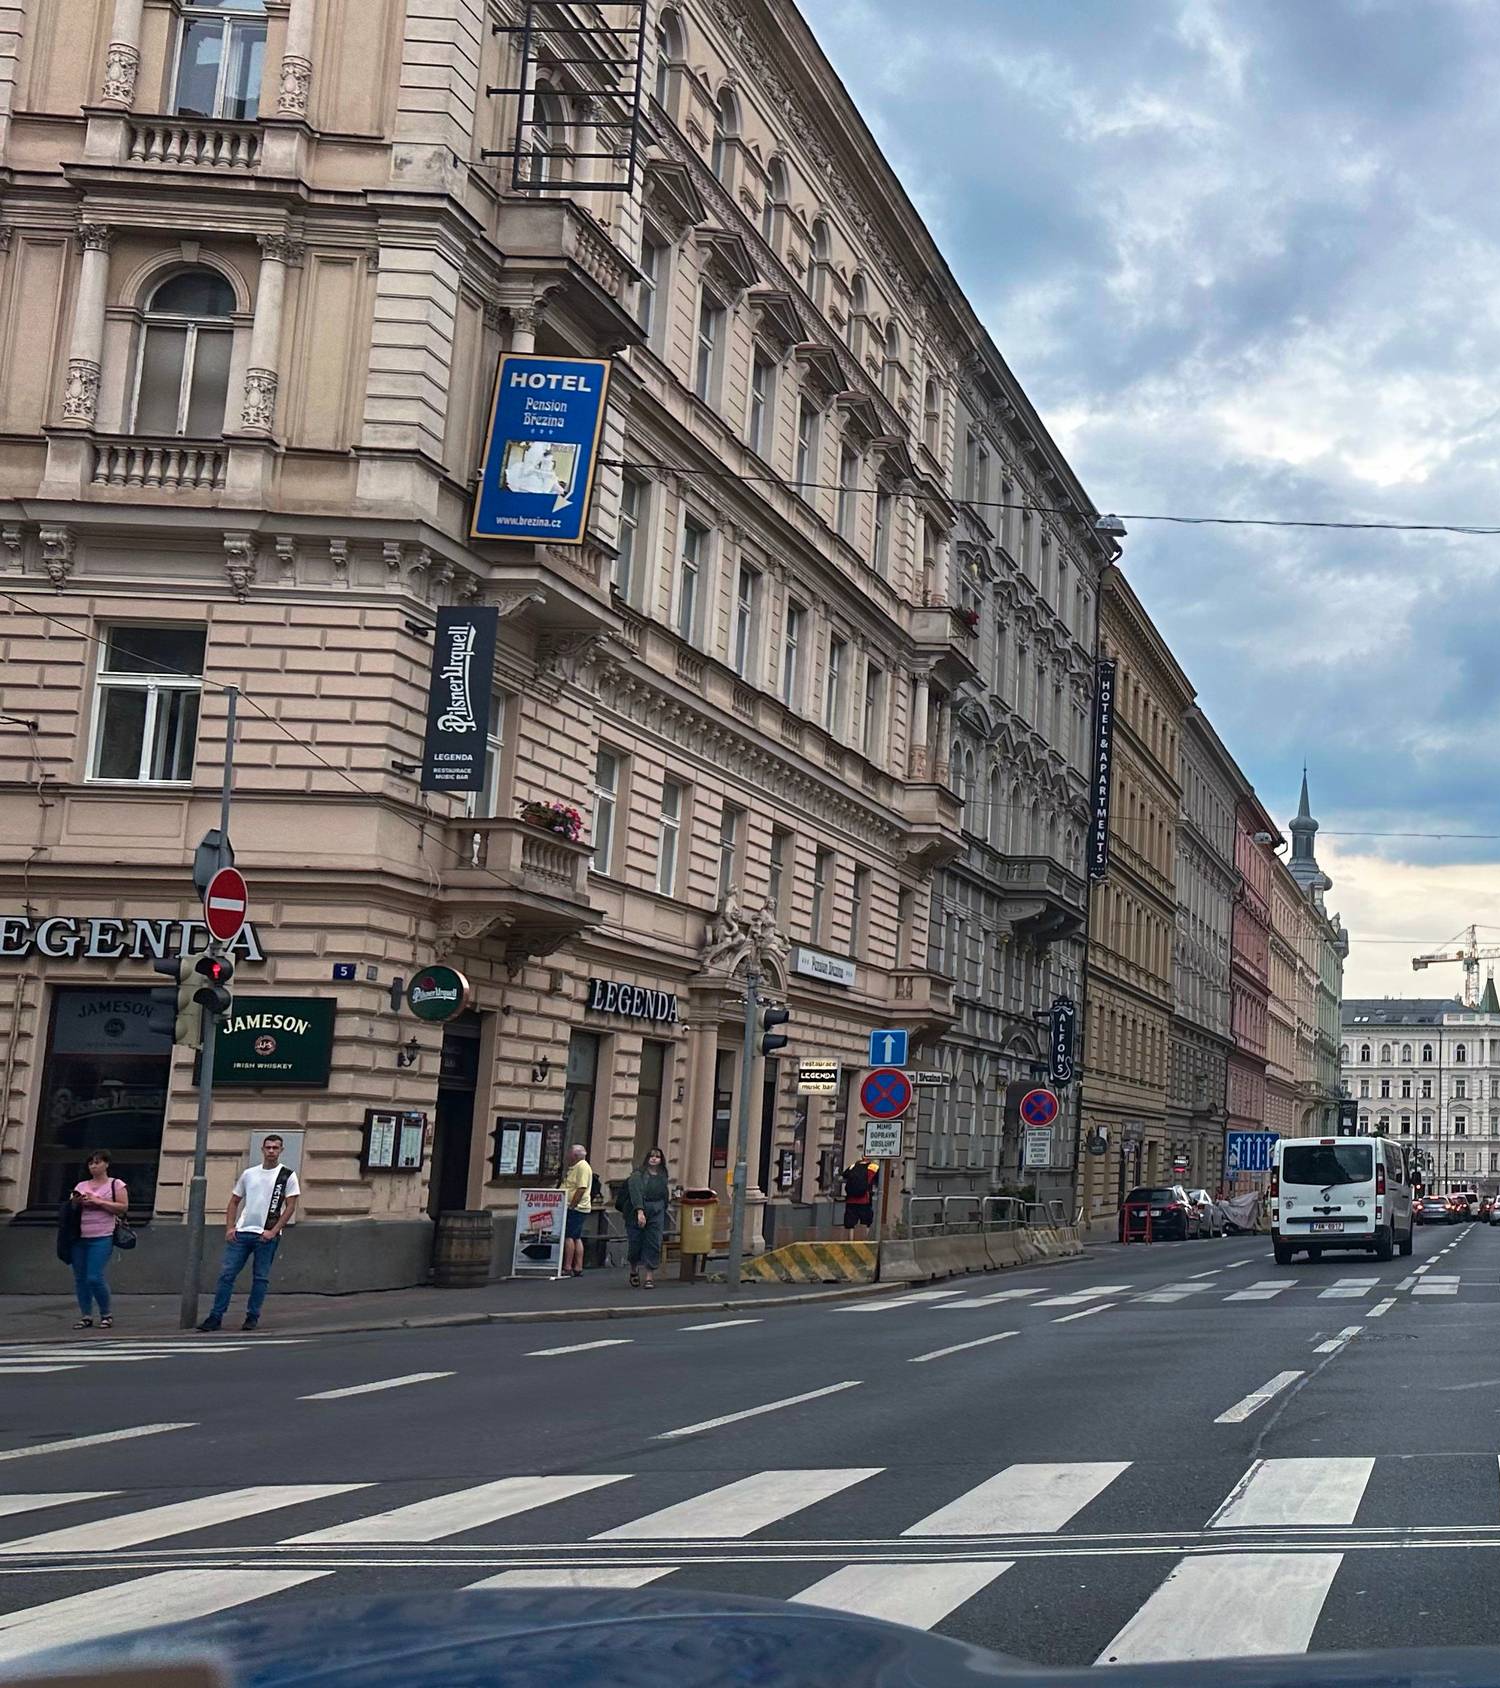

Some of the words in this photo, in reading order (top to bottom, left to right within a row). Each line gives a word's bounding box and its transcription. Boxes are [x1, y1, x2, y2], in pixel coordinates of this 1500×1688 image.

[510, 372, 592, 393] HOTEL
[525, 397, 567, 412] Pension
[523, 412, 565, 427] Březina
[496, 516, 562, 528] www.brezina.cz
[440, 626, 476, 679] Urquell
[437, 676, 477, 734] Pilsner
[1101, 681, 1110, 735] HOTEL
[1100, 738, 1109, 748] &
[434, 753, 473, 761] LEGENDA
[1096, 752, 1108, 864] APARTMENTS
[341, 966, 348, 976] 5
[78, 1000, 154, 1018] JAMESON
[592, 980, 679, 1022] LEGENDA
[223, 1014, 309, 1035] JAMESON
[1057, 1013, 1066, 1073] ALFONS
[257, 1062, 293, 1070] WHISKEY
[801, 1072, 836, 1080] LEGENDA
[870, 1130, 898, 1139] DOPRAVNÍ
[270, 1183, 283, 1213] VICTORY
